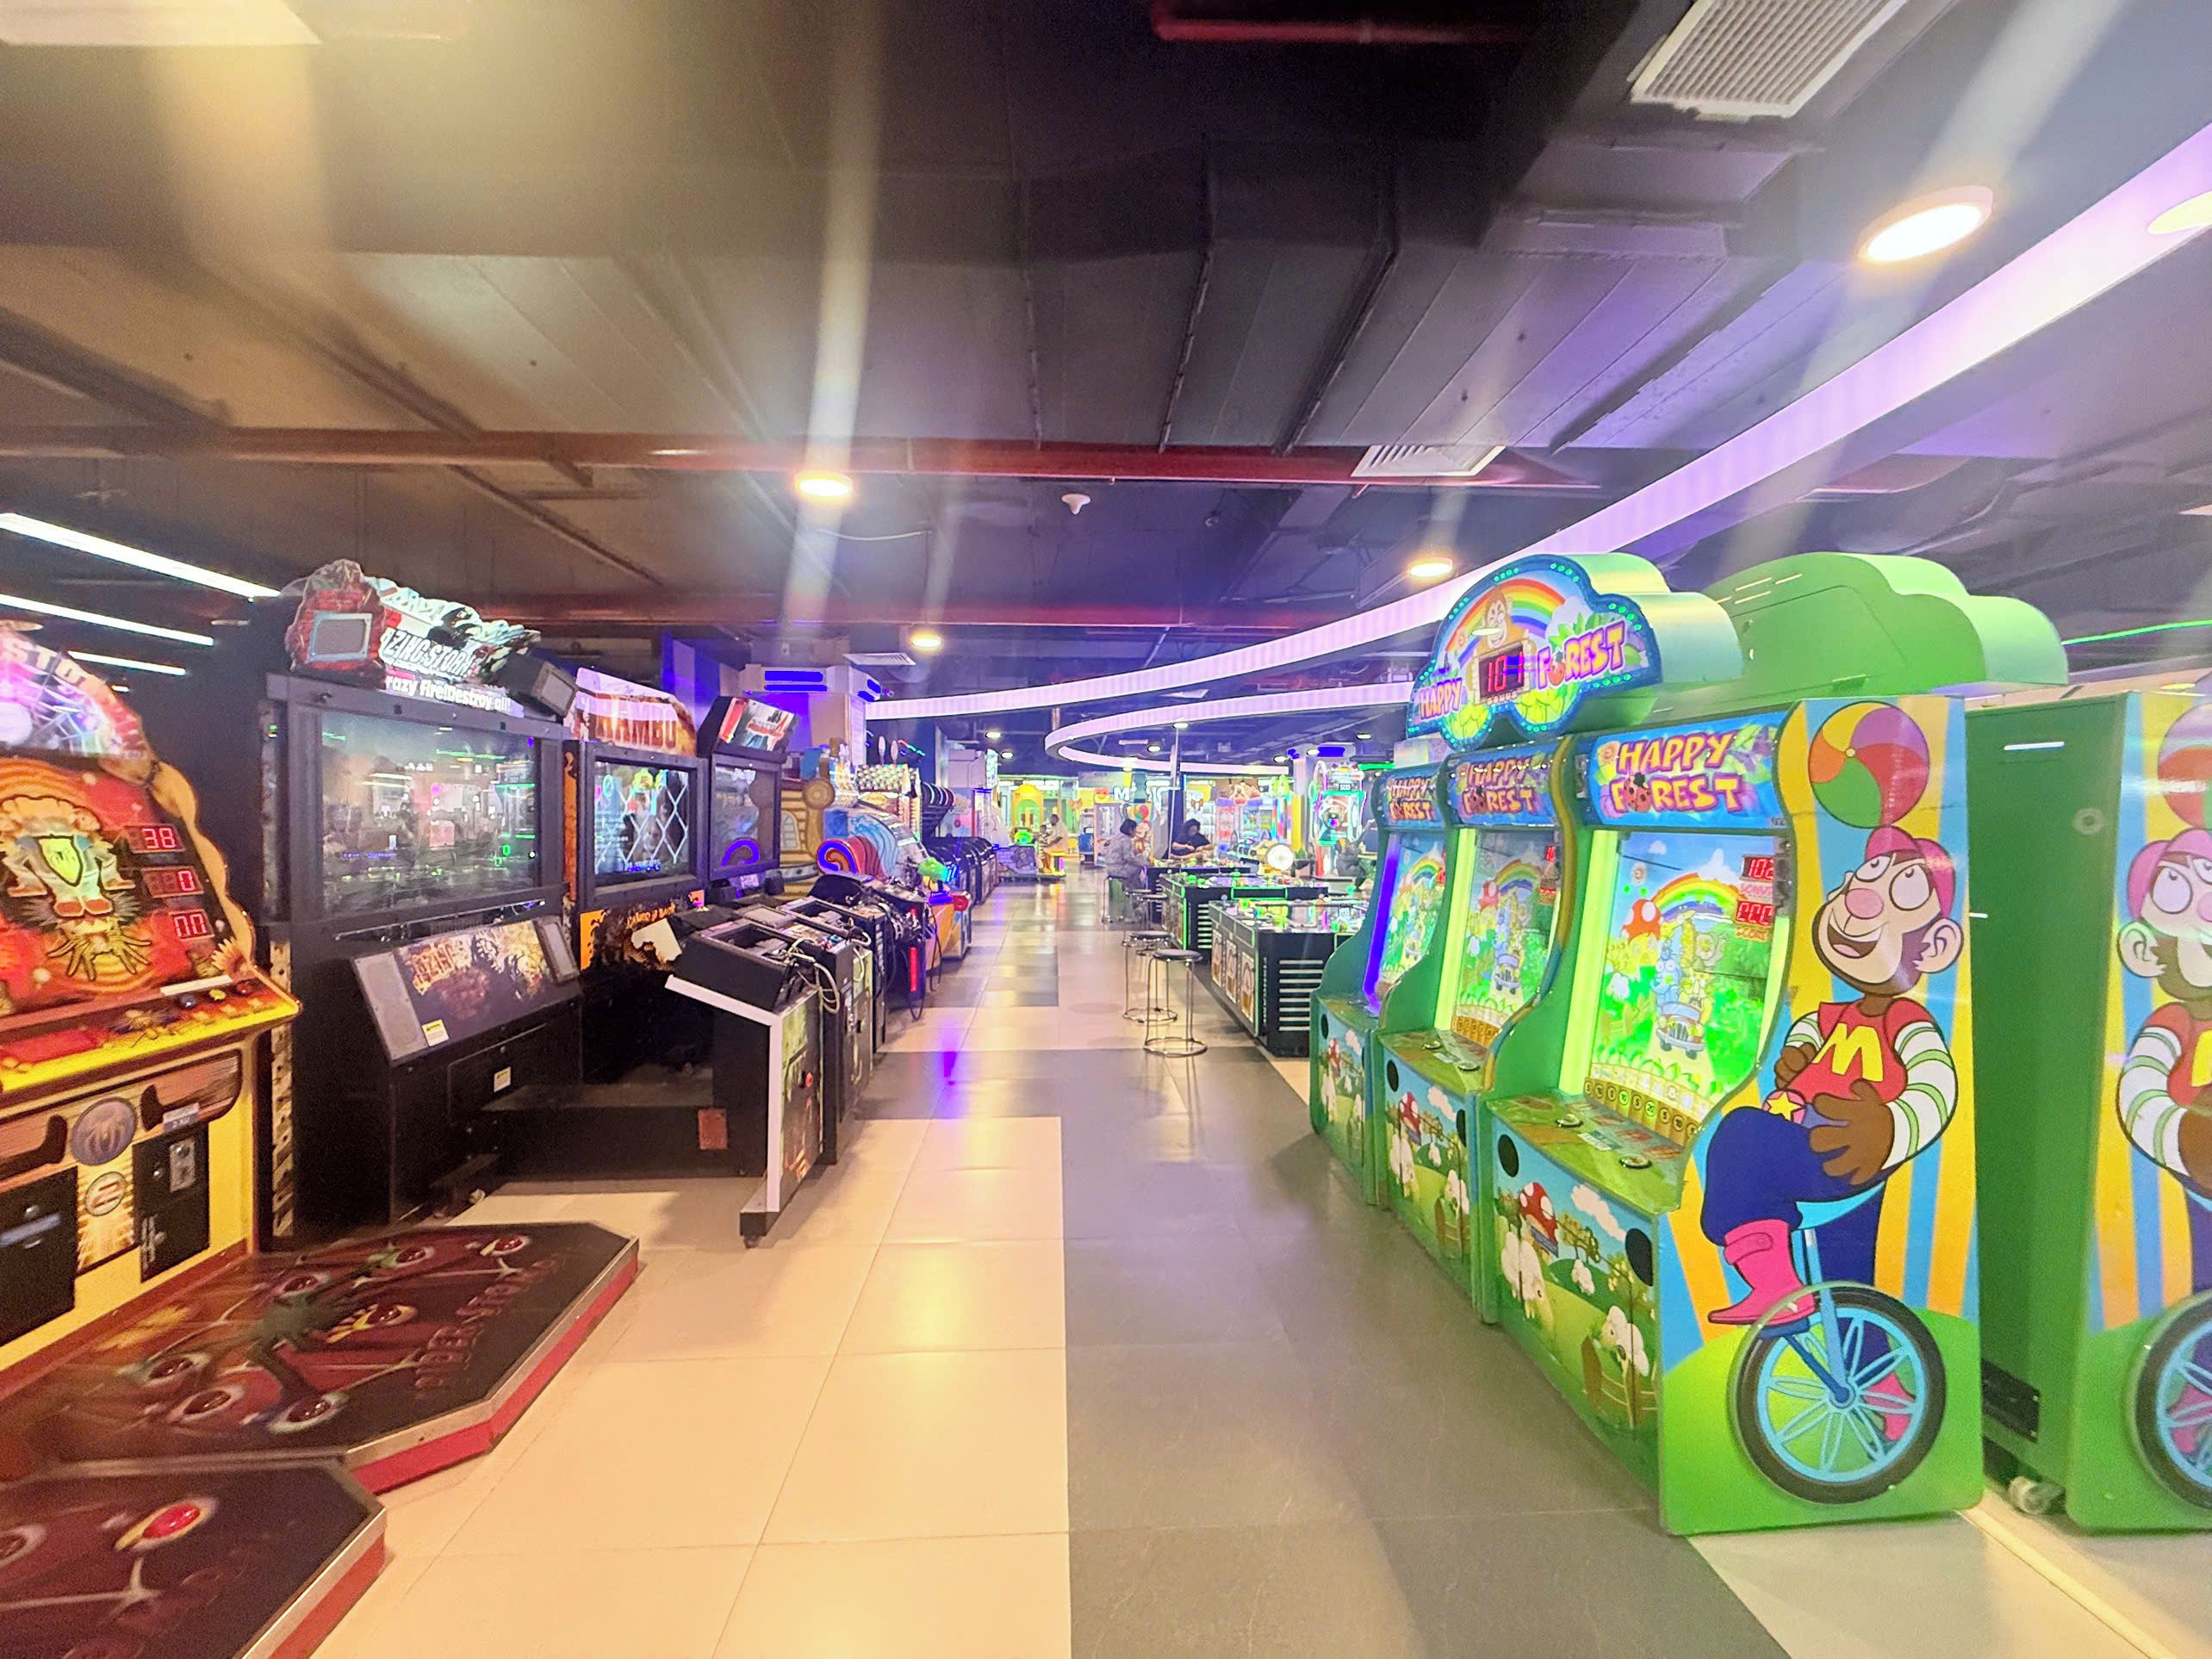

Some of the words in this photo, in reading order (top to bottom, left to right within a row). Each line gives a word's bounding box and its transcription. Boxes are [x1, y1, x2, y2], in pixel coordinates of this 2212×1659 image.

[386, 675, 419, 697] razy
[1420, 677, 1463, 721] HAPPY
[595, 694, 677, 749] RAMBO
[1616, 730, 1738, 774] HAPPY
[1467, 756, 1532, 785] HAPPY
[1390, 775, 1431, 798] HAPPY
[141, 827, 177, 849] 38
[177, 870, 196, 892] 0
[1811, 1022, 1884, 1083] M
